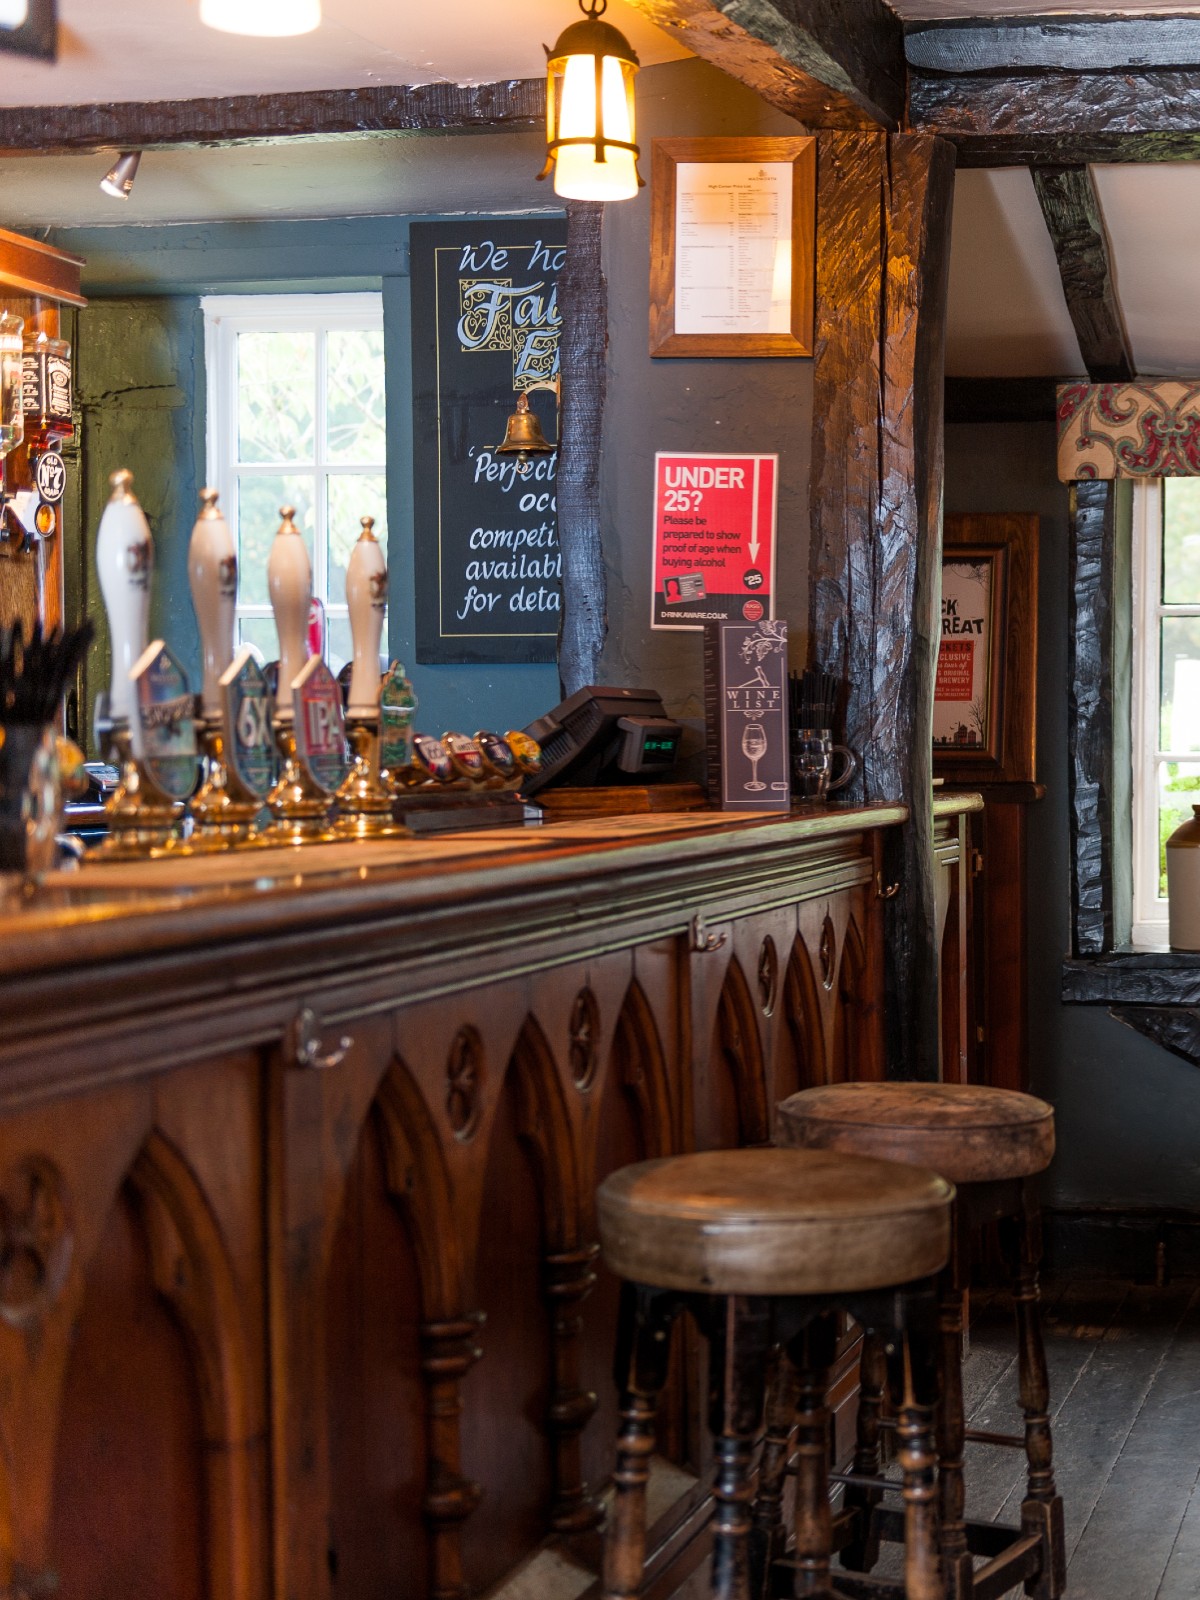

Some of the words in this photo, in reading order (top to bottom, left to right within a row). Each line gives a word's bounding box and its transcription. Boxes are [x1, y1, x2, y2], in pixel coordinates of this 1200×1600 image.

[459, 240, 508, 272] We
[527, 240, 567, 271] ha
[46, 455, 58, 465] OLD
[665, 466, 745, 489] UNDER
[664, 490, 703, 512] 25?
[663, 516, 694, 525] Please
[695, 516, 707, 526] be
[469, 521, 560, 552] competi
[663, 530, 704, 541] prepared
[706, 531, 714, 540] to
[716, 530, 741, 540] show
[662, 543, 687, 555] proof
[689, 544, 698, 553] of
[698, 546, 715, 556] age
[716, 544, 742, 554] when
[466, 553, 562, 580] availabl
[662, 557, 692, 569] buying
[694, 557, 726, 567] alcohol
[457, 585, 501, 620] for
[509, 585, 561, 612] deta
[942, 617, 984, 635] REAT
[940, 643, 971, 652] CKETS
[938, 653, 971, 661] CLUSIVE
[726, 690, 780, 699] WINE
[733, 700, 775, 709] LIST
[238, 696, 271, 748] 6X
[309, 699, 340, 749] IPA
